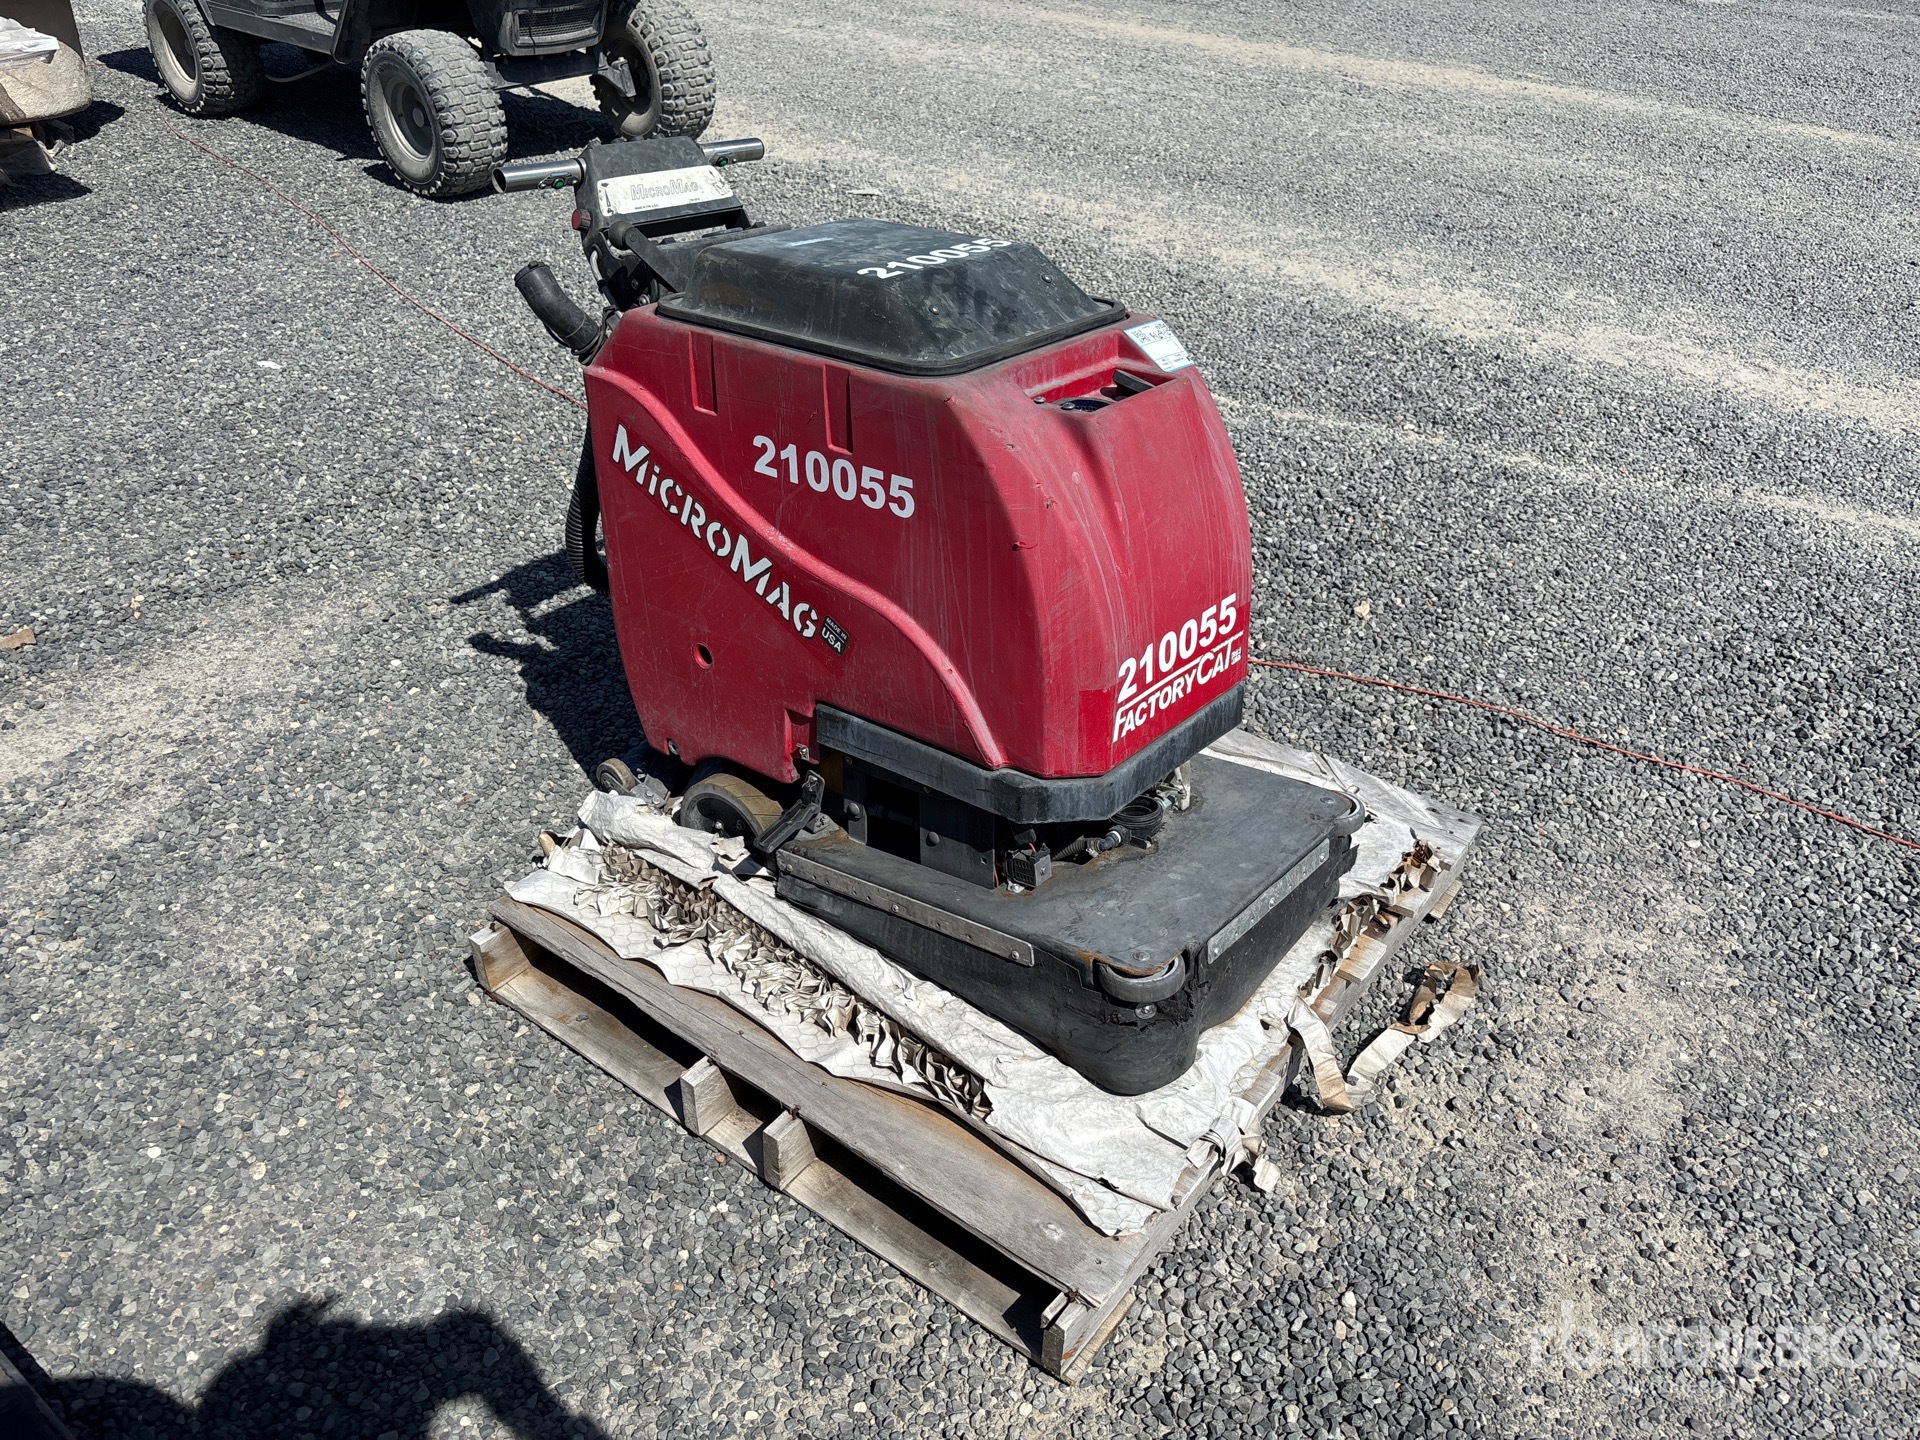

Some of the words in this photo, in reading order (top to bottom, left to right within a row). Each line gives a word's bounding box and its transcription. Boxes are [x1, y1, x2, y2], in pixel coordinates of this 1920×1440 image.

[857, 238, 1012, 280] 210055
[752, 435, 916, 518] 210055
[821, 626, 841, 652] USA
[826, 617, 841, 633] MADE
[1117, 592, 1237, 704] 210055
